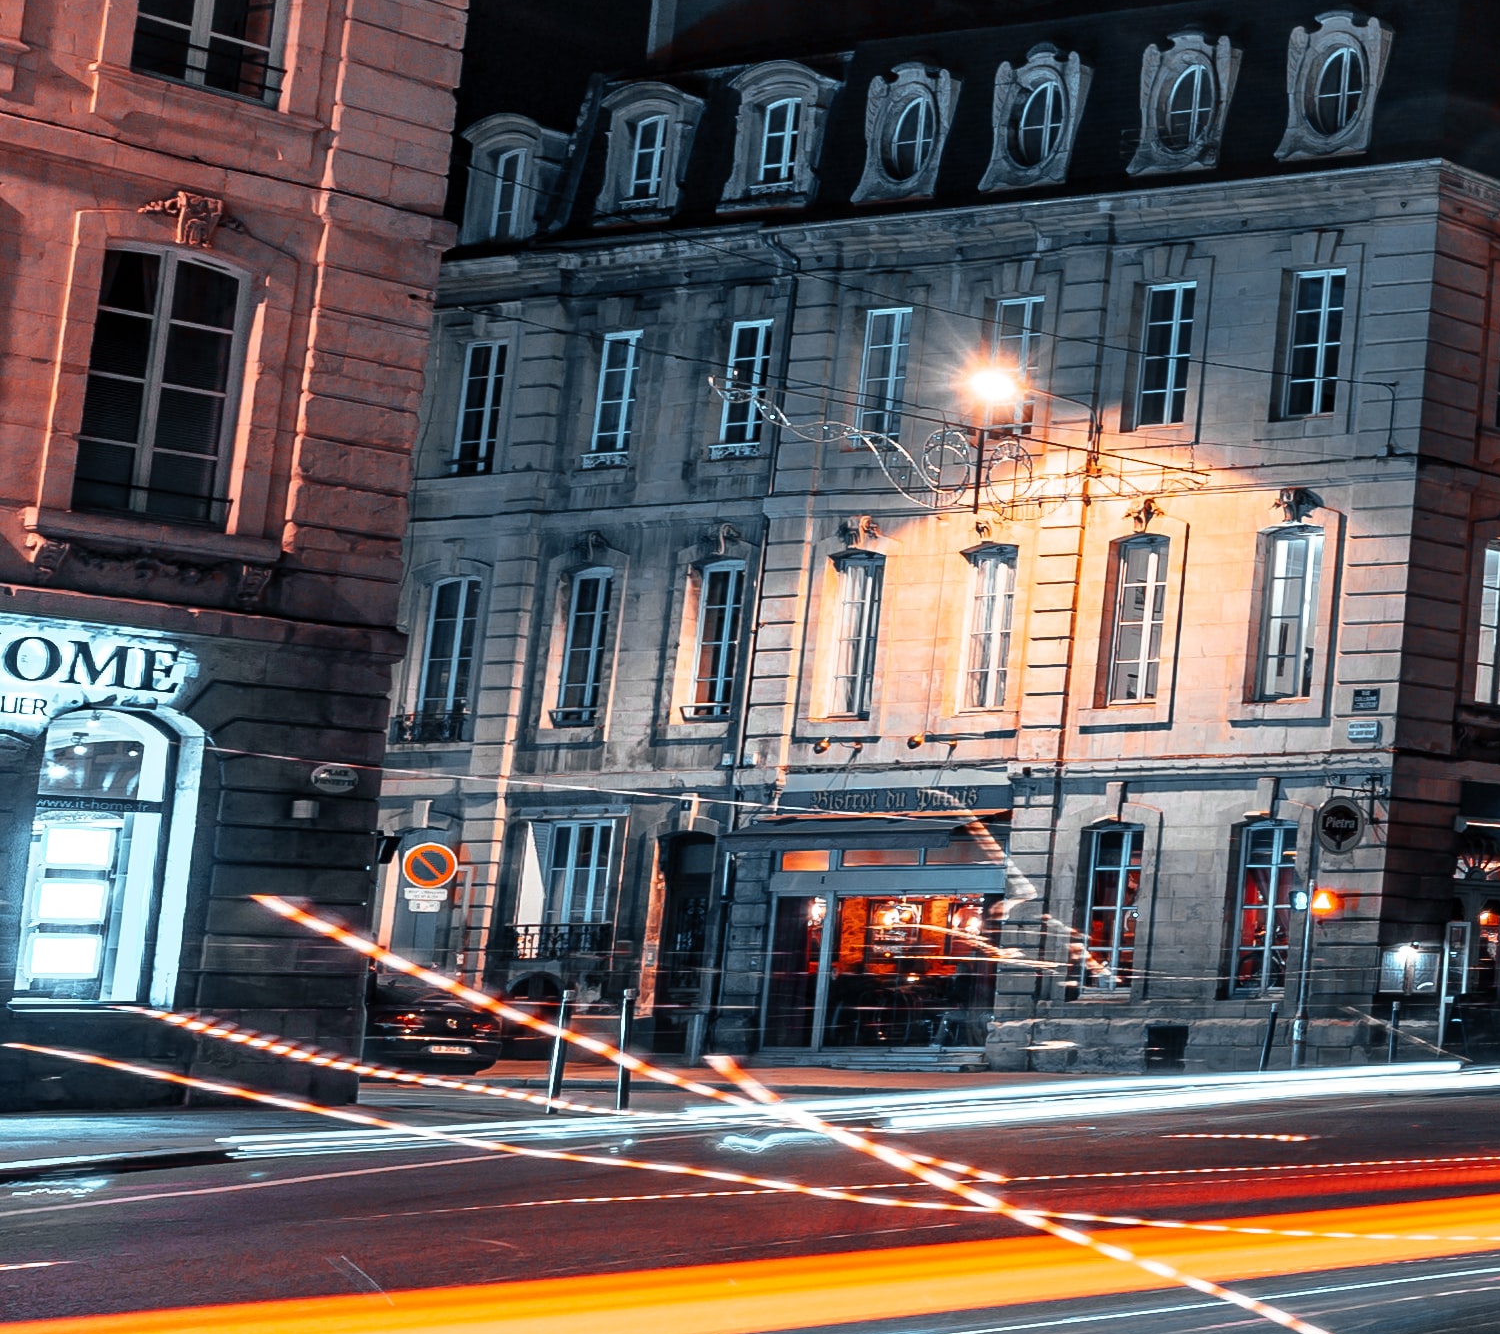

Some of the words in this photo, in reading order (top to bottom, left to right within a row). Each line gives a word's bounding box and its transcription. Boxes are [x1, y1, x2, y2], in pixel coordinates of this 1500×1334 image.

[0, 635, 179, 693] OME
[36, 798, 150, 812] www.it-home.fr
[884, 790, 906, 809] du
[1325, 816, 1356, 829] Pietra
